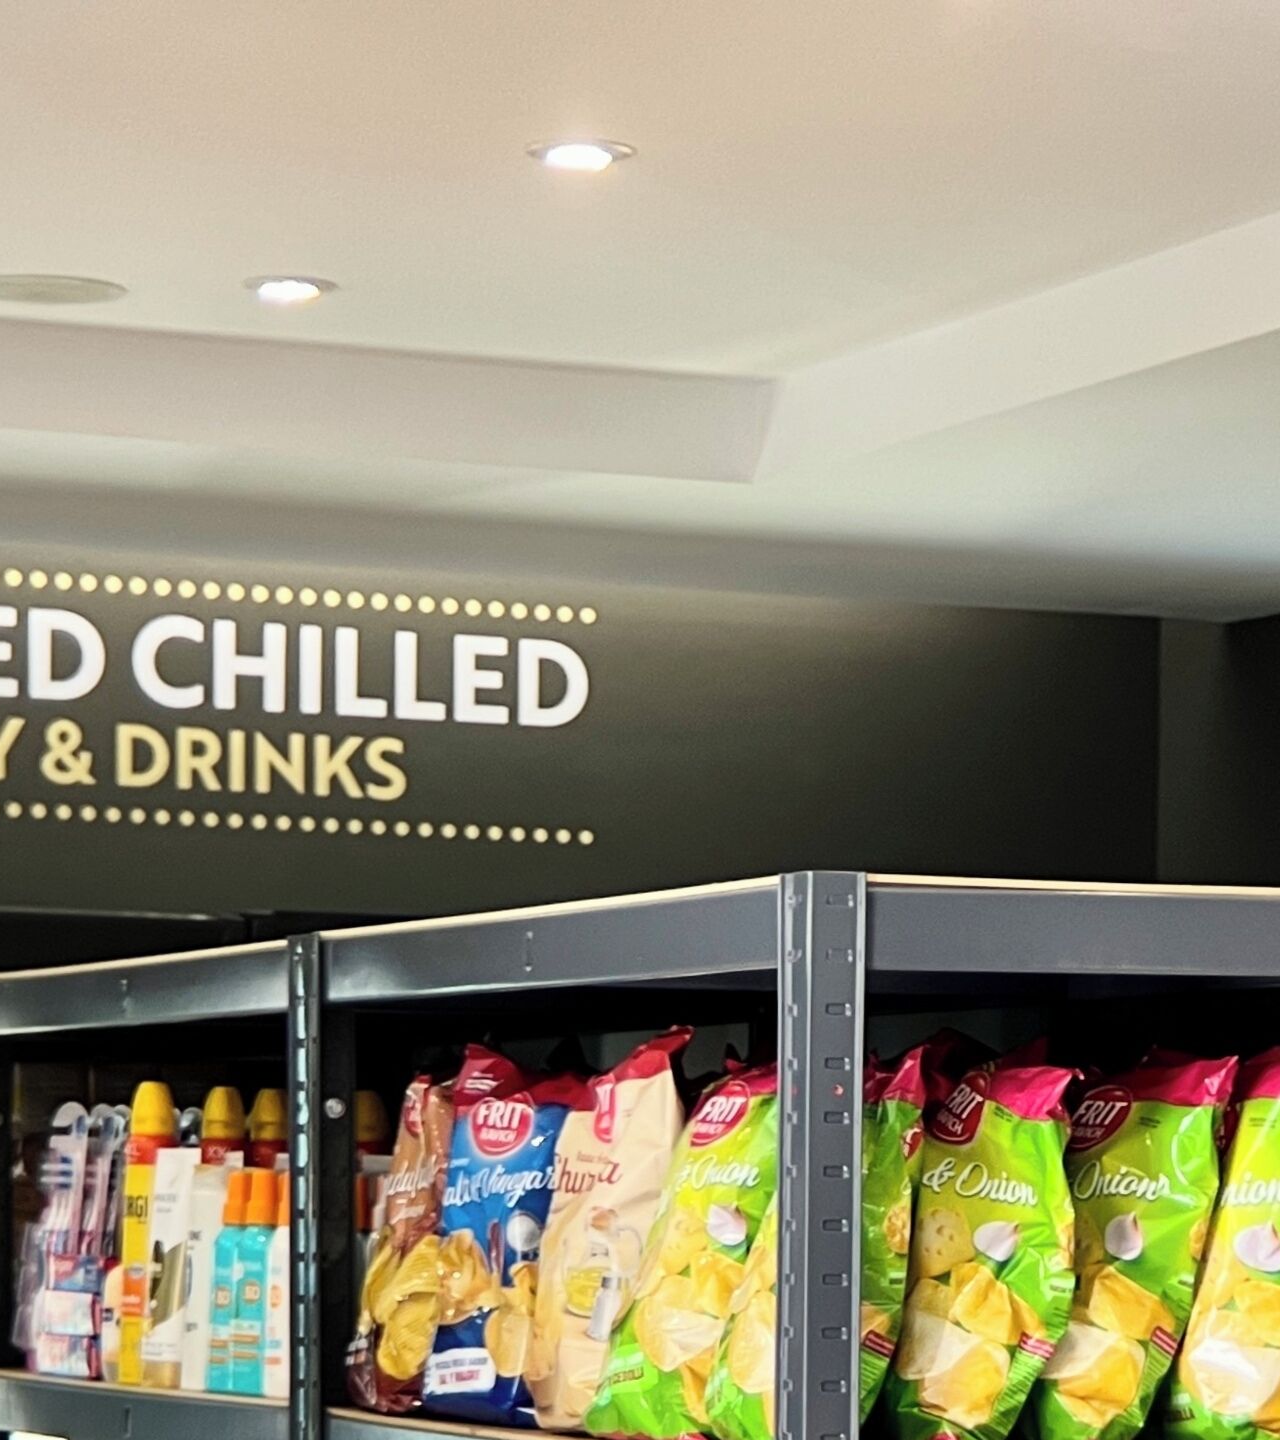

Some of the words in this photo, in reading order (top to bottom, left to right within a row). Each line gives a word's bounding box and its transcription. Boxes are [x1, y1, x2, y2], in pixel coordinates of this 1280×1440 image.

[131, 614, 589, 727] CHILLED
[41, 719, 96, 785] &
[116, 723, 407, 801] DRINKS
[476, 1100, 523, 1129] FRIT
[698, 1095, 746, 1123] FRIT
[944, 1083, 984, 1120] FRIT
[1074, 1099, 1128, 1126] FRIT
[922, 1157, 956, 1193] &
[955, 1161, 1038, 1206] Onion
